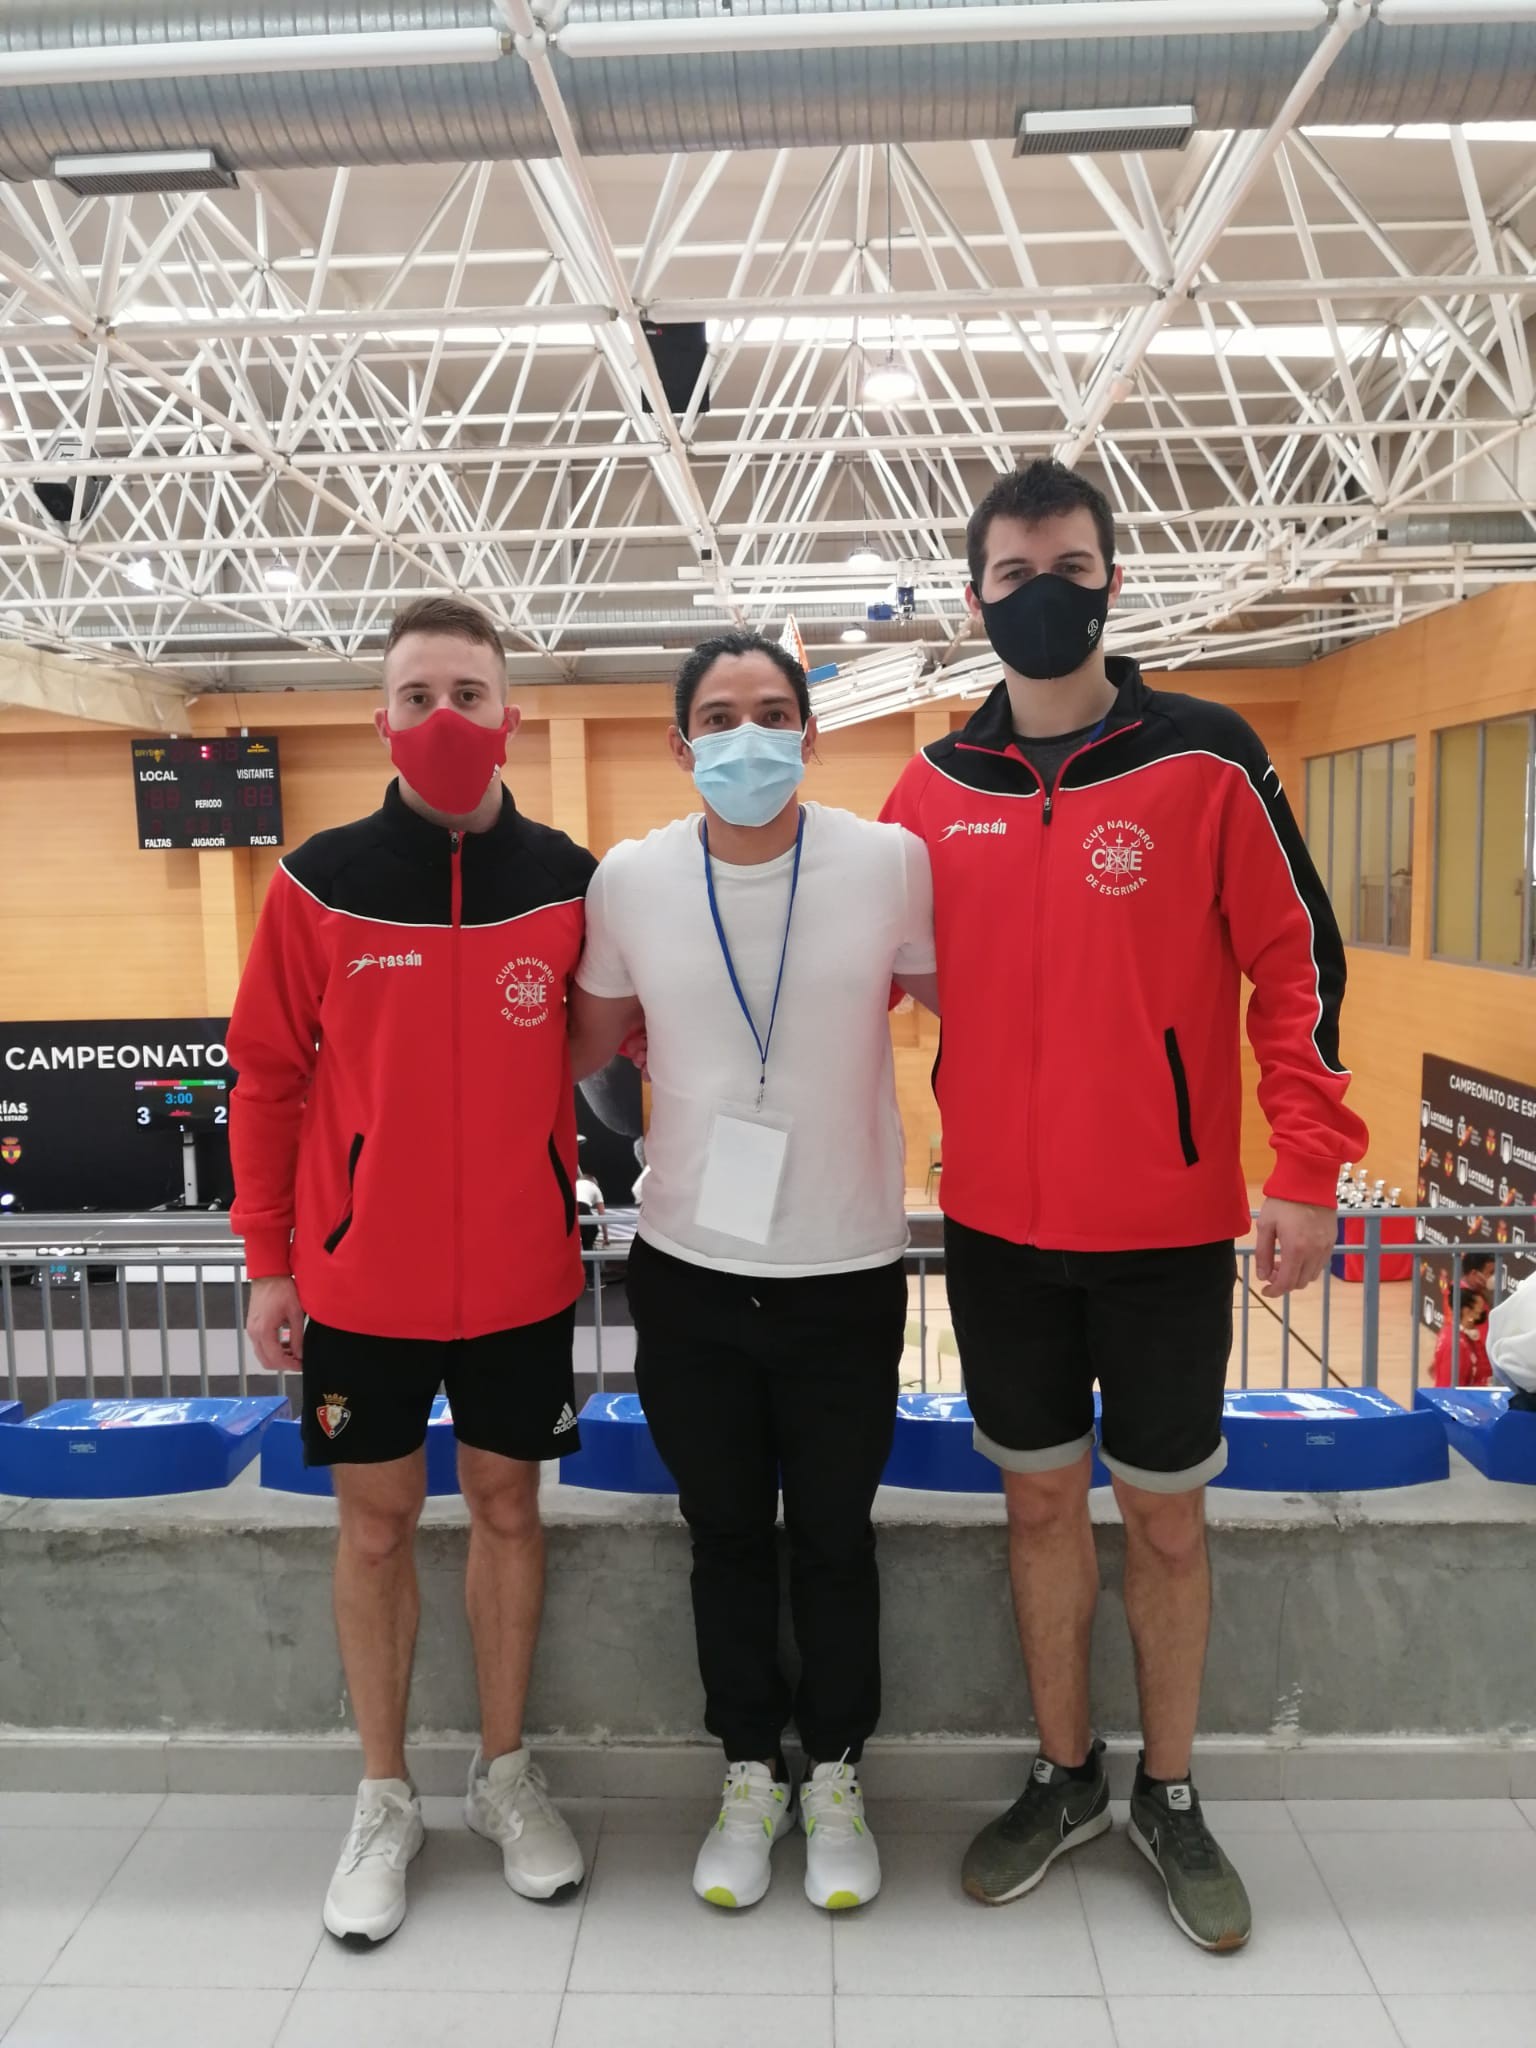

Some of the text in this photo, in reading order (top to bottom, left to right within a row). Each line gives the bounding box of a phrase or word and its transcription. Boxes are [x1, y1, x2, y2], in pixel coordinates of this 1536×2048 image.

[139, 770, 178, 781] LOCAL
[236, 768, 275, 779] VISITANTE
[195, 799, 222, 808] PERIODO
[967, 818, 1007, 836] rasán
[1082, 819, 1154, 850] CLUB NAVARRO
[144, 838, 172, 848] FALTAS
[191, 837, 226, 847] JUGADOR
[250, 835, 278, 845] FALTAS
[1085, 873, 1148, 896] DE ESGRIMA
[378, 950, 422, 969] rasán
[495, 956, 555, 985] CLUB NAVARRO
[500, 1007, 514, 1021] DE
[5, 1043, 229, 1070] CAMPEONATO
[165, 1093, 193, 1105] 3:00
[1449, 1074, 1505, 1107] CAMPEONATO
[1506, 1094, 1520, 1113] DE
[136, 1106, 151, 1125] 3
[214, 1105, 228, 1124] 2
